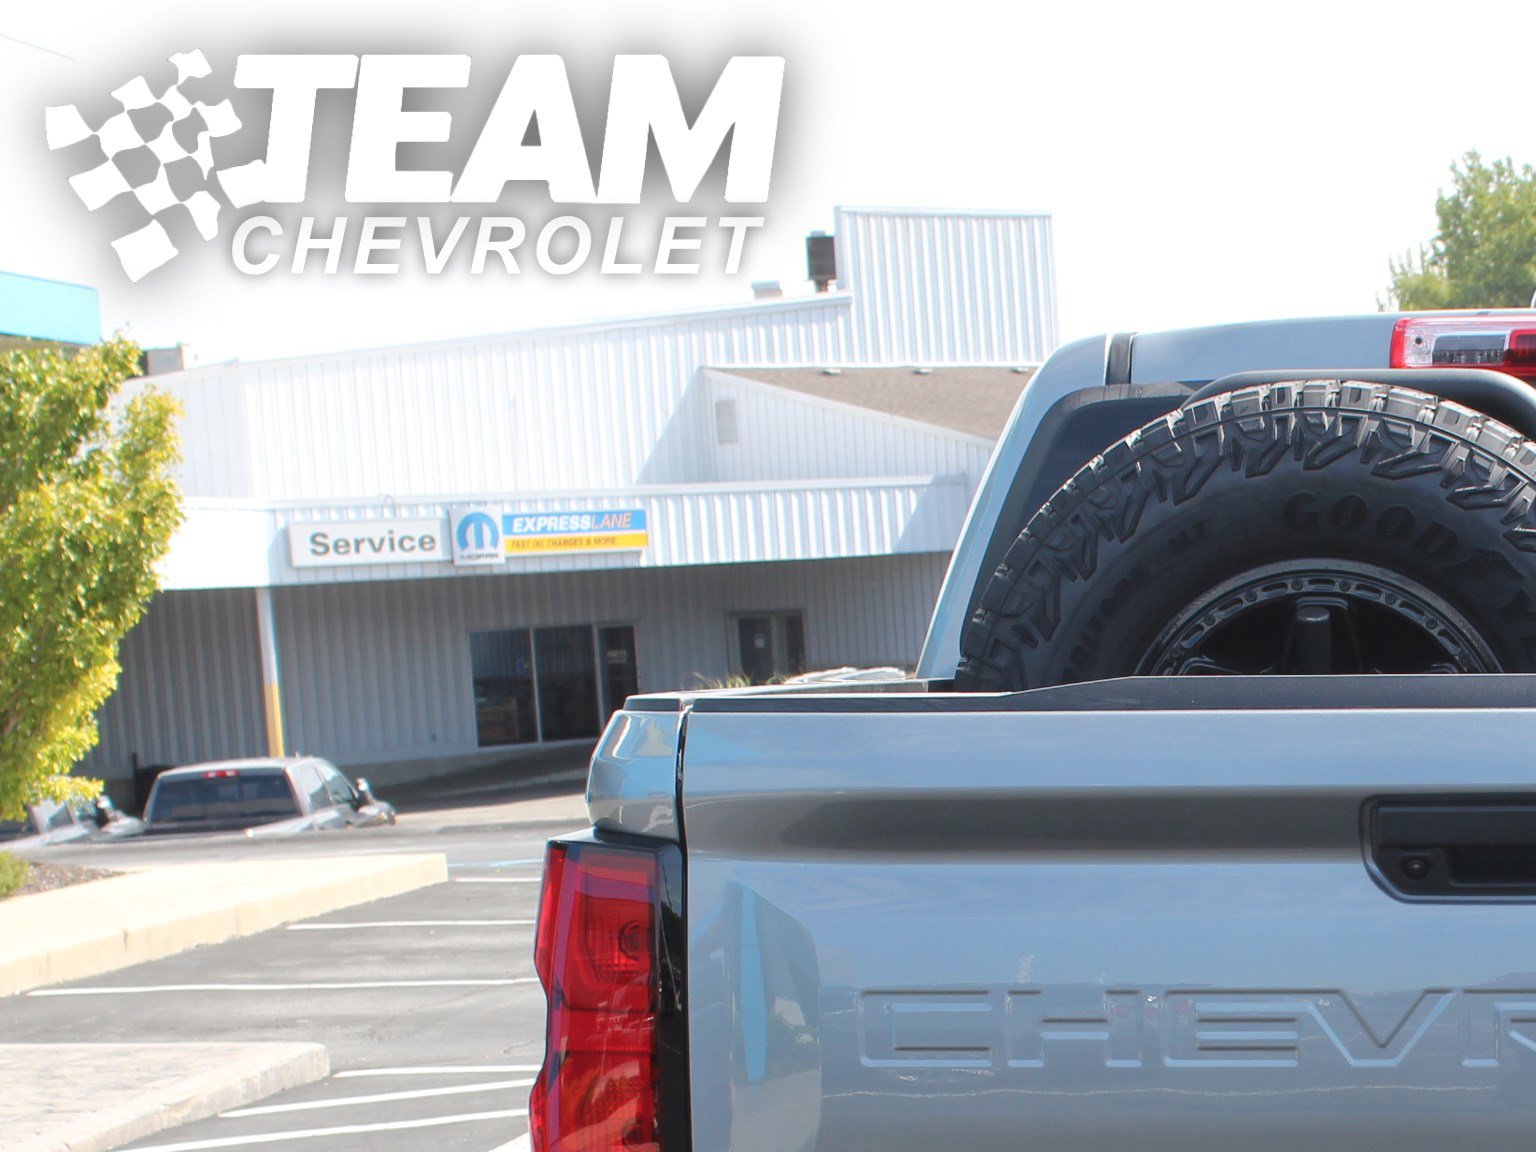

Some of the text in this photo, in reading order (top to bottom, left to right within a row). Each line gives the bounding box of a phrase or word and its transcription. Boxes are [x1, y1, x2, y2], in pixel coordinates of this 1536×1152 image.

[309, 530, 436, 556] Service
[511, 539, 530, 549] FAST
[546, 537, 583, 548] CHANGES
[593, 536, 616, 546] MORE
